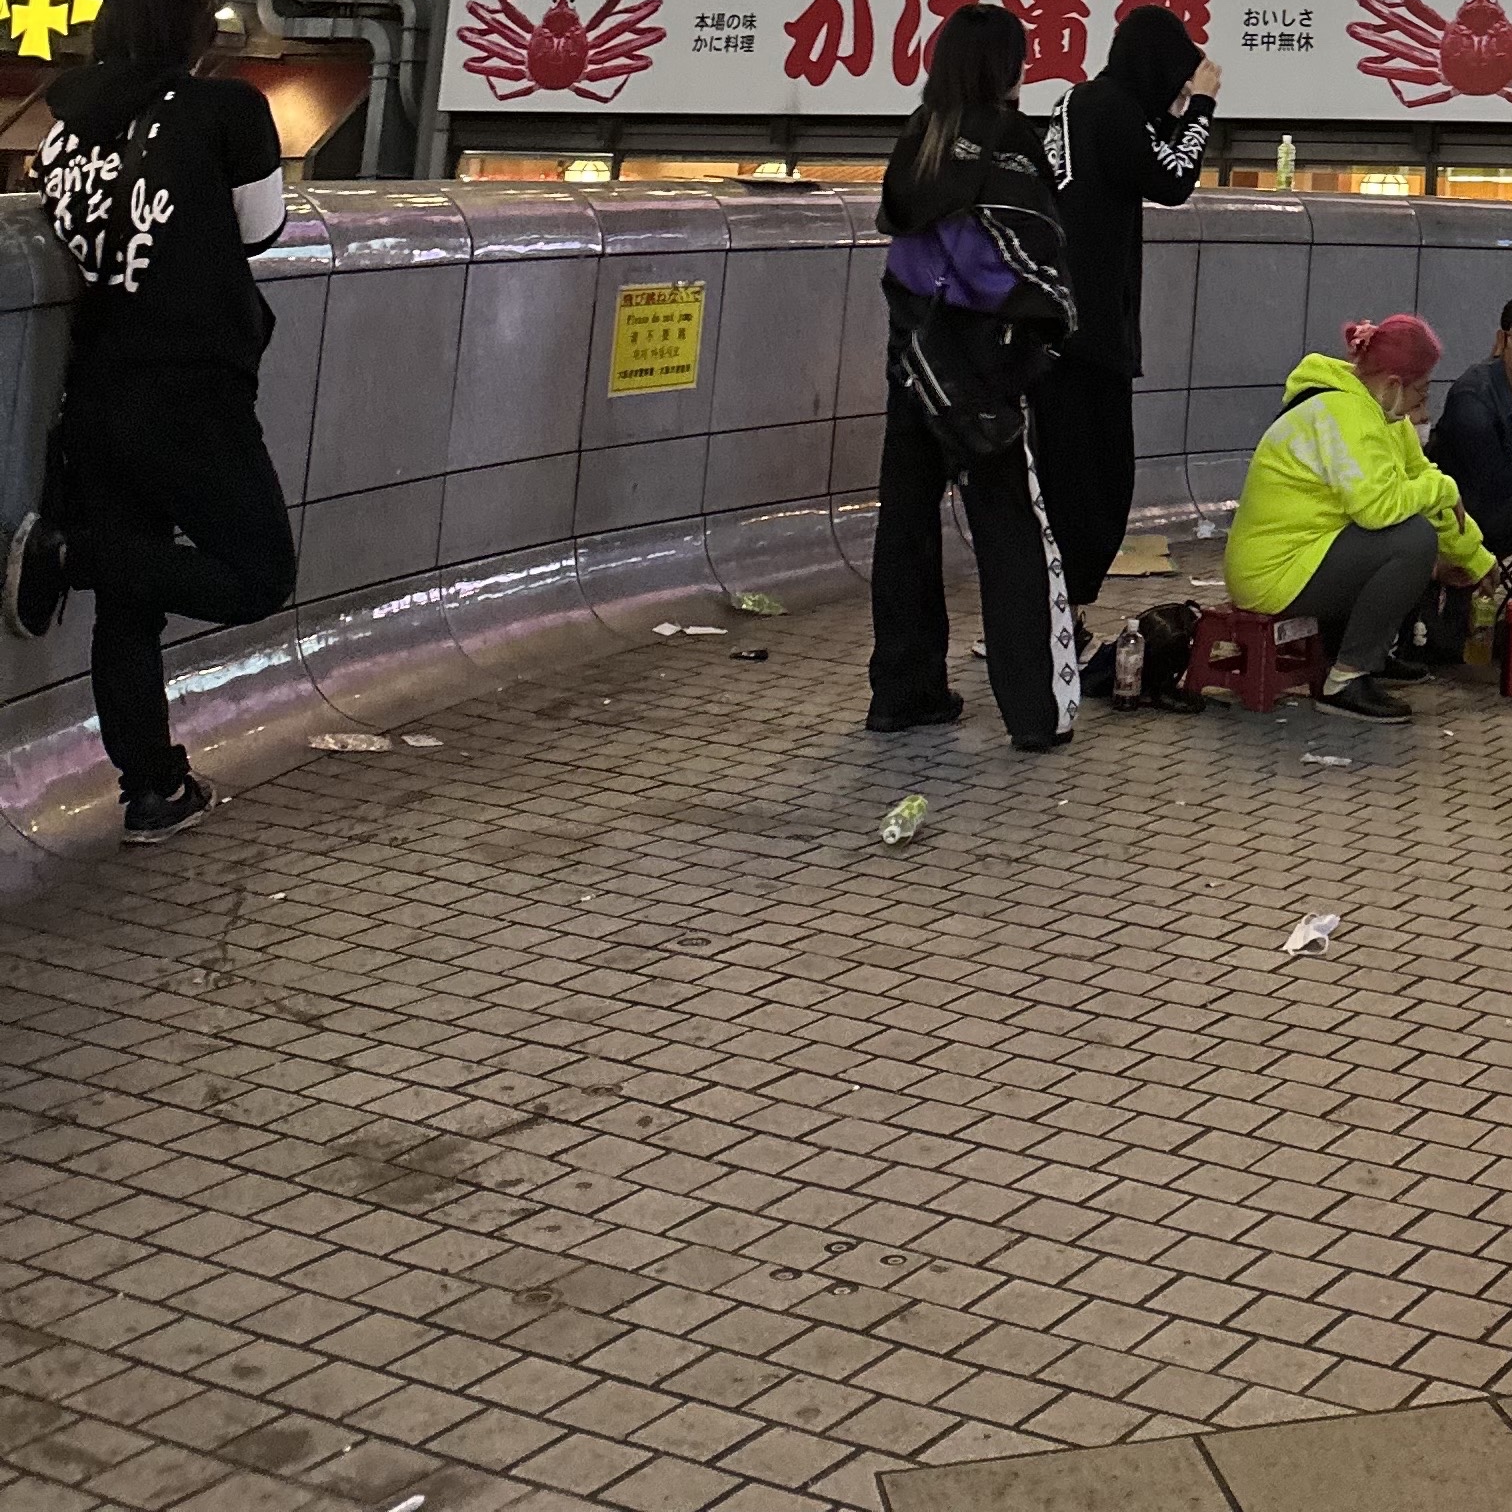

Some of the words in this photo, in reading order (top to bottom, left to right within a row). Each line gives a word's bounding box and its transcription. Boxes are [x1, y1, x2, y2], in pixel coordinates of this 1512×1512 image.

[694, 12, 757, 32] 本場の味
[1242, 8, 1315, 29] おいしさ
[692, 34, 755, 55] かに料理
[1240, 30, 1315, 53] 年中無休
